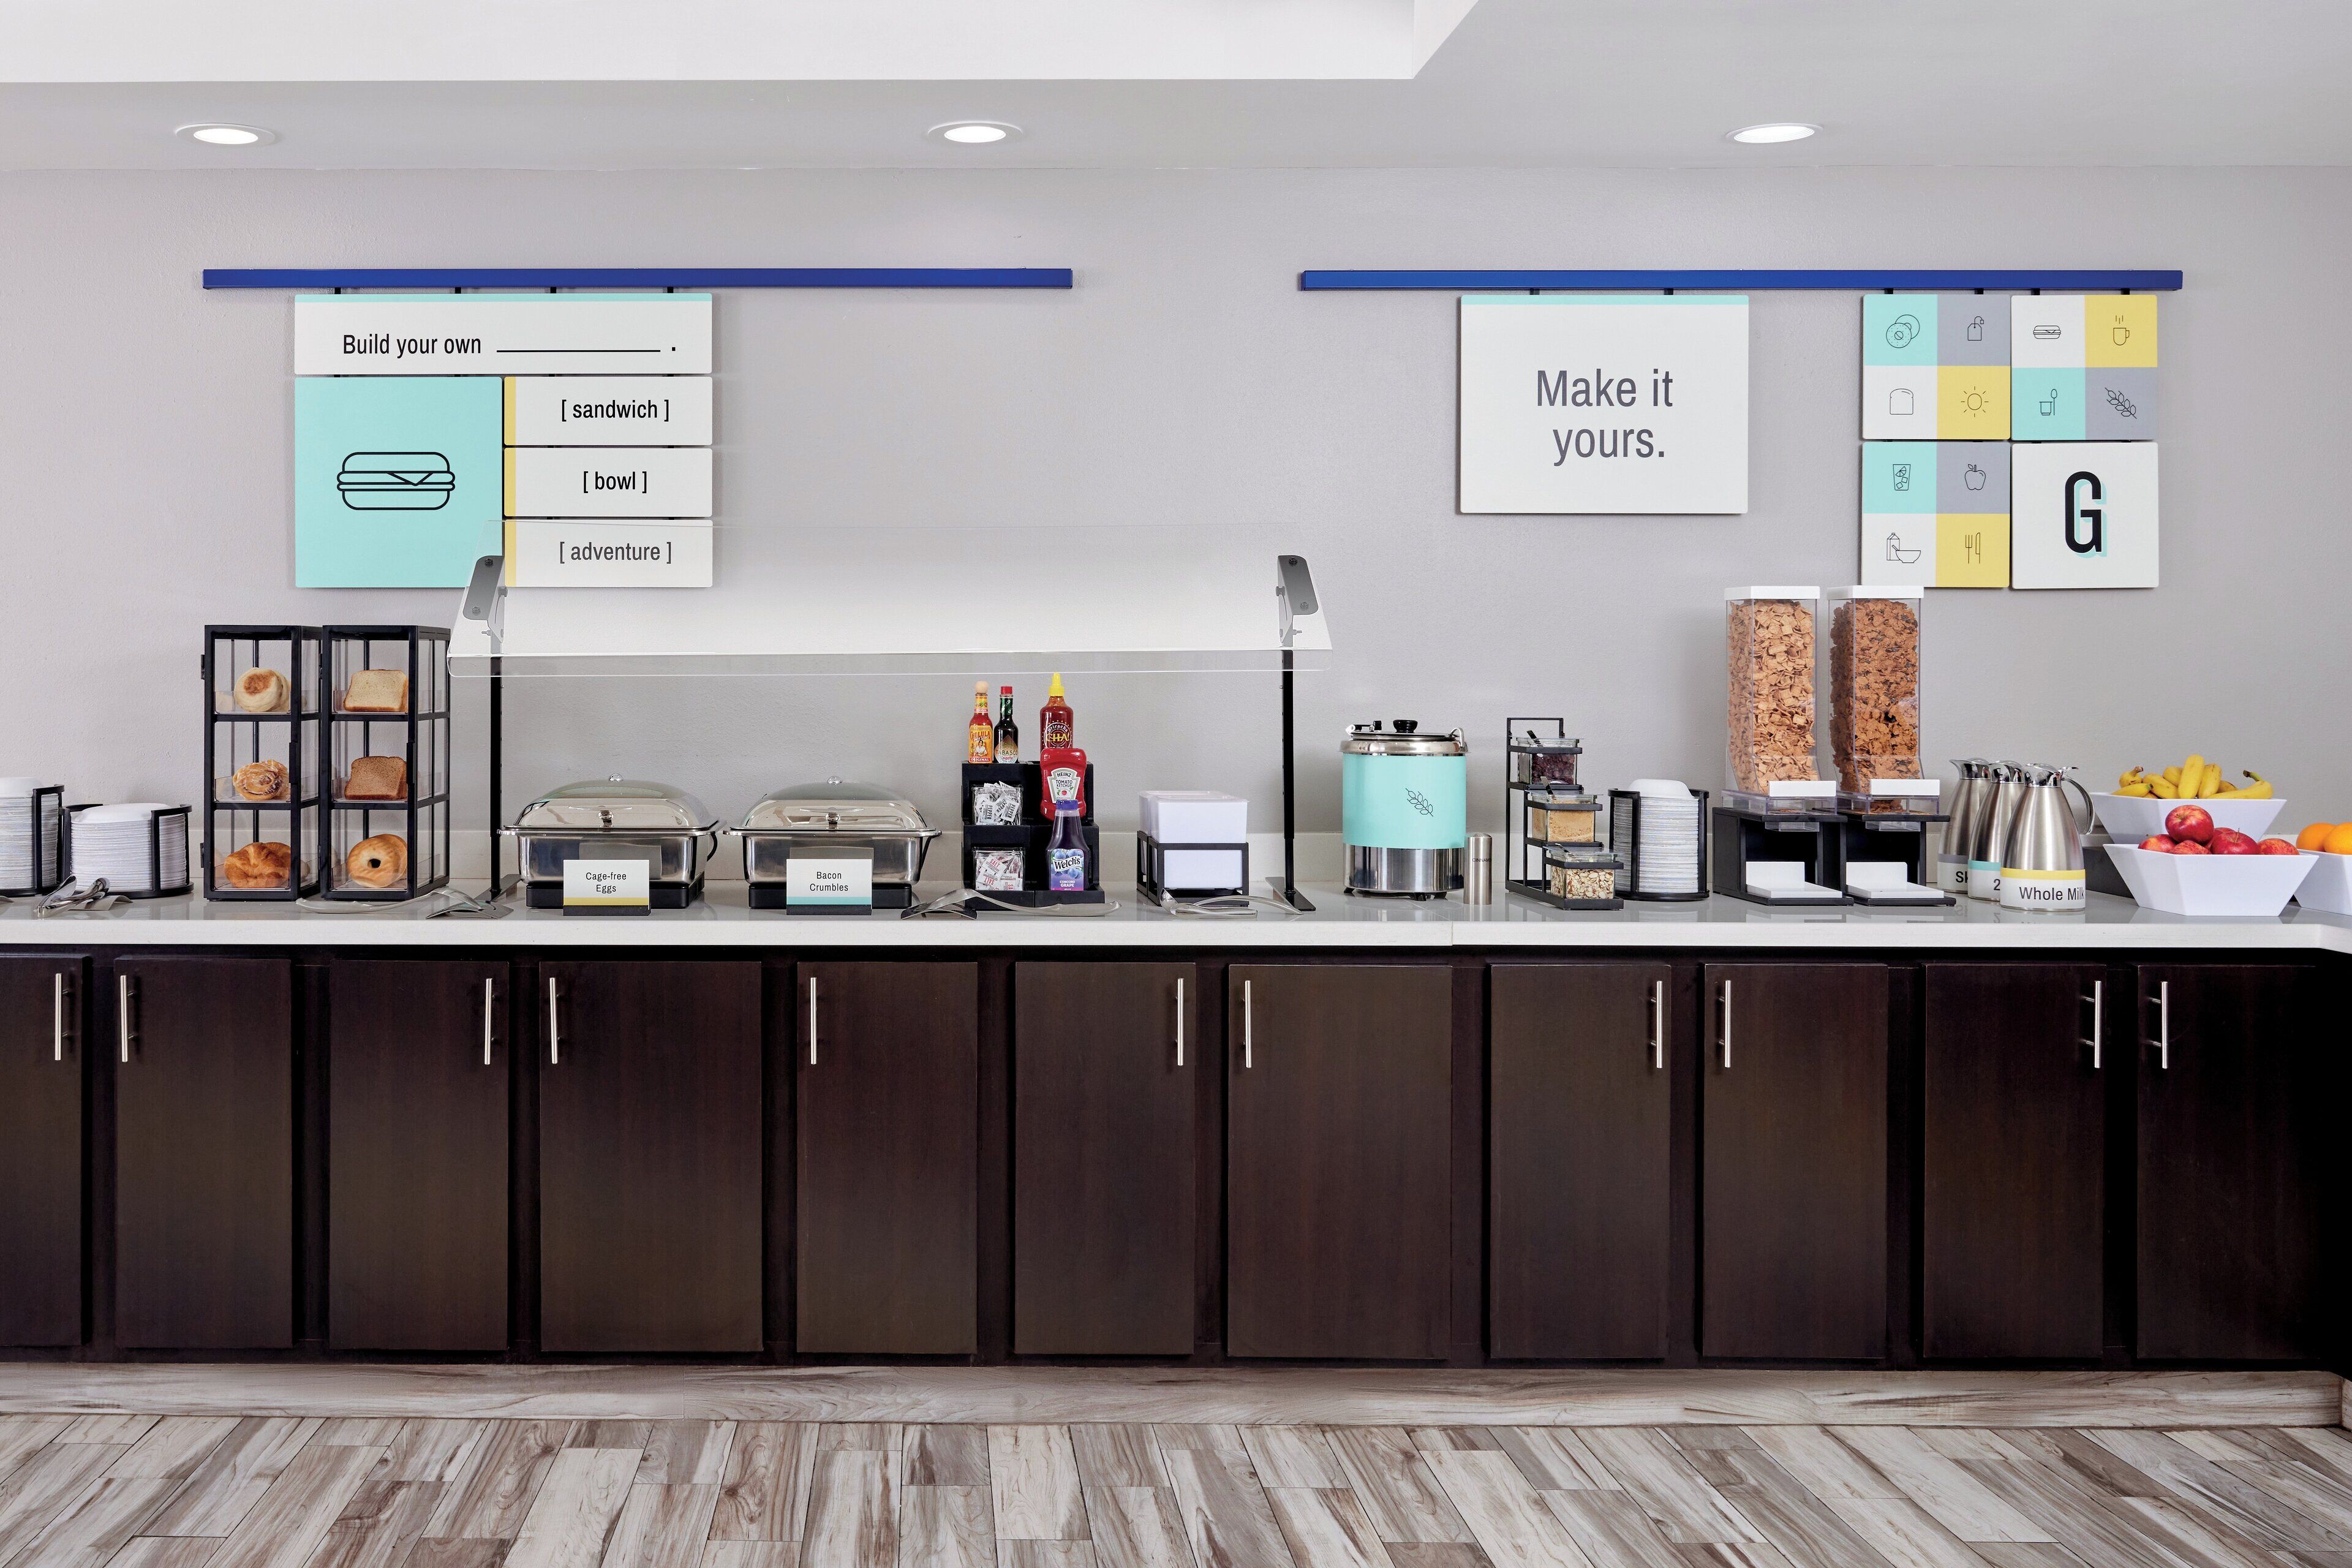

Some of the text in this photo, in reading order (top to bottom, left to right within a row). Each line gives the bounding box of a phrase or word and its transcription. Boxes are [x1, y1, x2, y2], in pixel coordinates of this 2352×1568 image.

[343, 333, 390, 355] Build
[396, 338, 438, 359] your
[444, 338, 481, 355] own
[1537, 368, 1673, 407] Make it
[572, 399, 658, 419] sandwich
[1553, 429, 1665, 467] yours.
[595, 471, 636, 491] bowl
[2065, 471, 2102, 554] G
[570, 541, 661, 561] adventure
[1047, 732, 1069, 741] CHA!
[1007, 804, 1016, 818] PEPPER
[989, 858, 1001, 868] SALT
[1054, 857, 1080, 870] Welch's
[586, 872, 627, 882] Cage-free
[816, 871, 842, 880] Bacon
[984, 877, 995, 886] SALT
[596, 884, 617, 894] Eggs
[810, 883, 849, 892] Crumbles
[2019, 886, 2084, 901] Whole Milk
